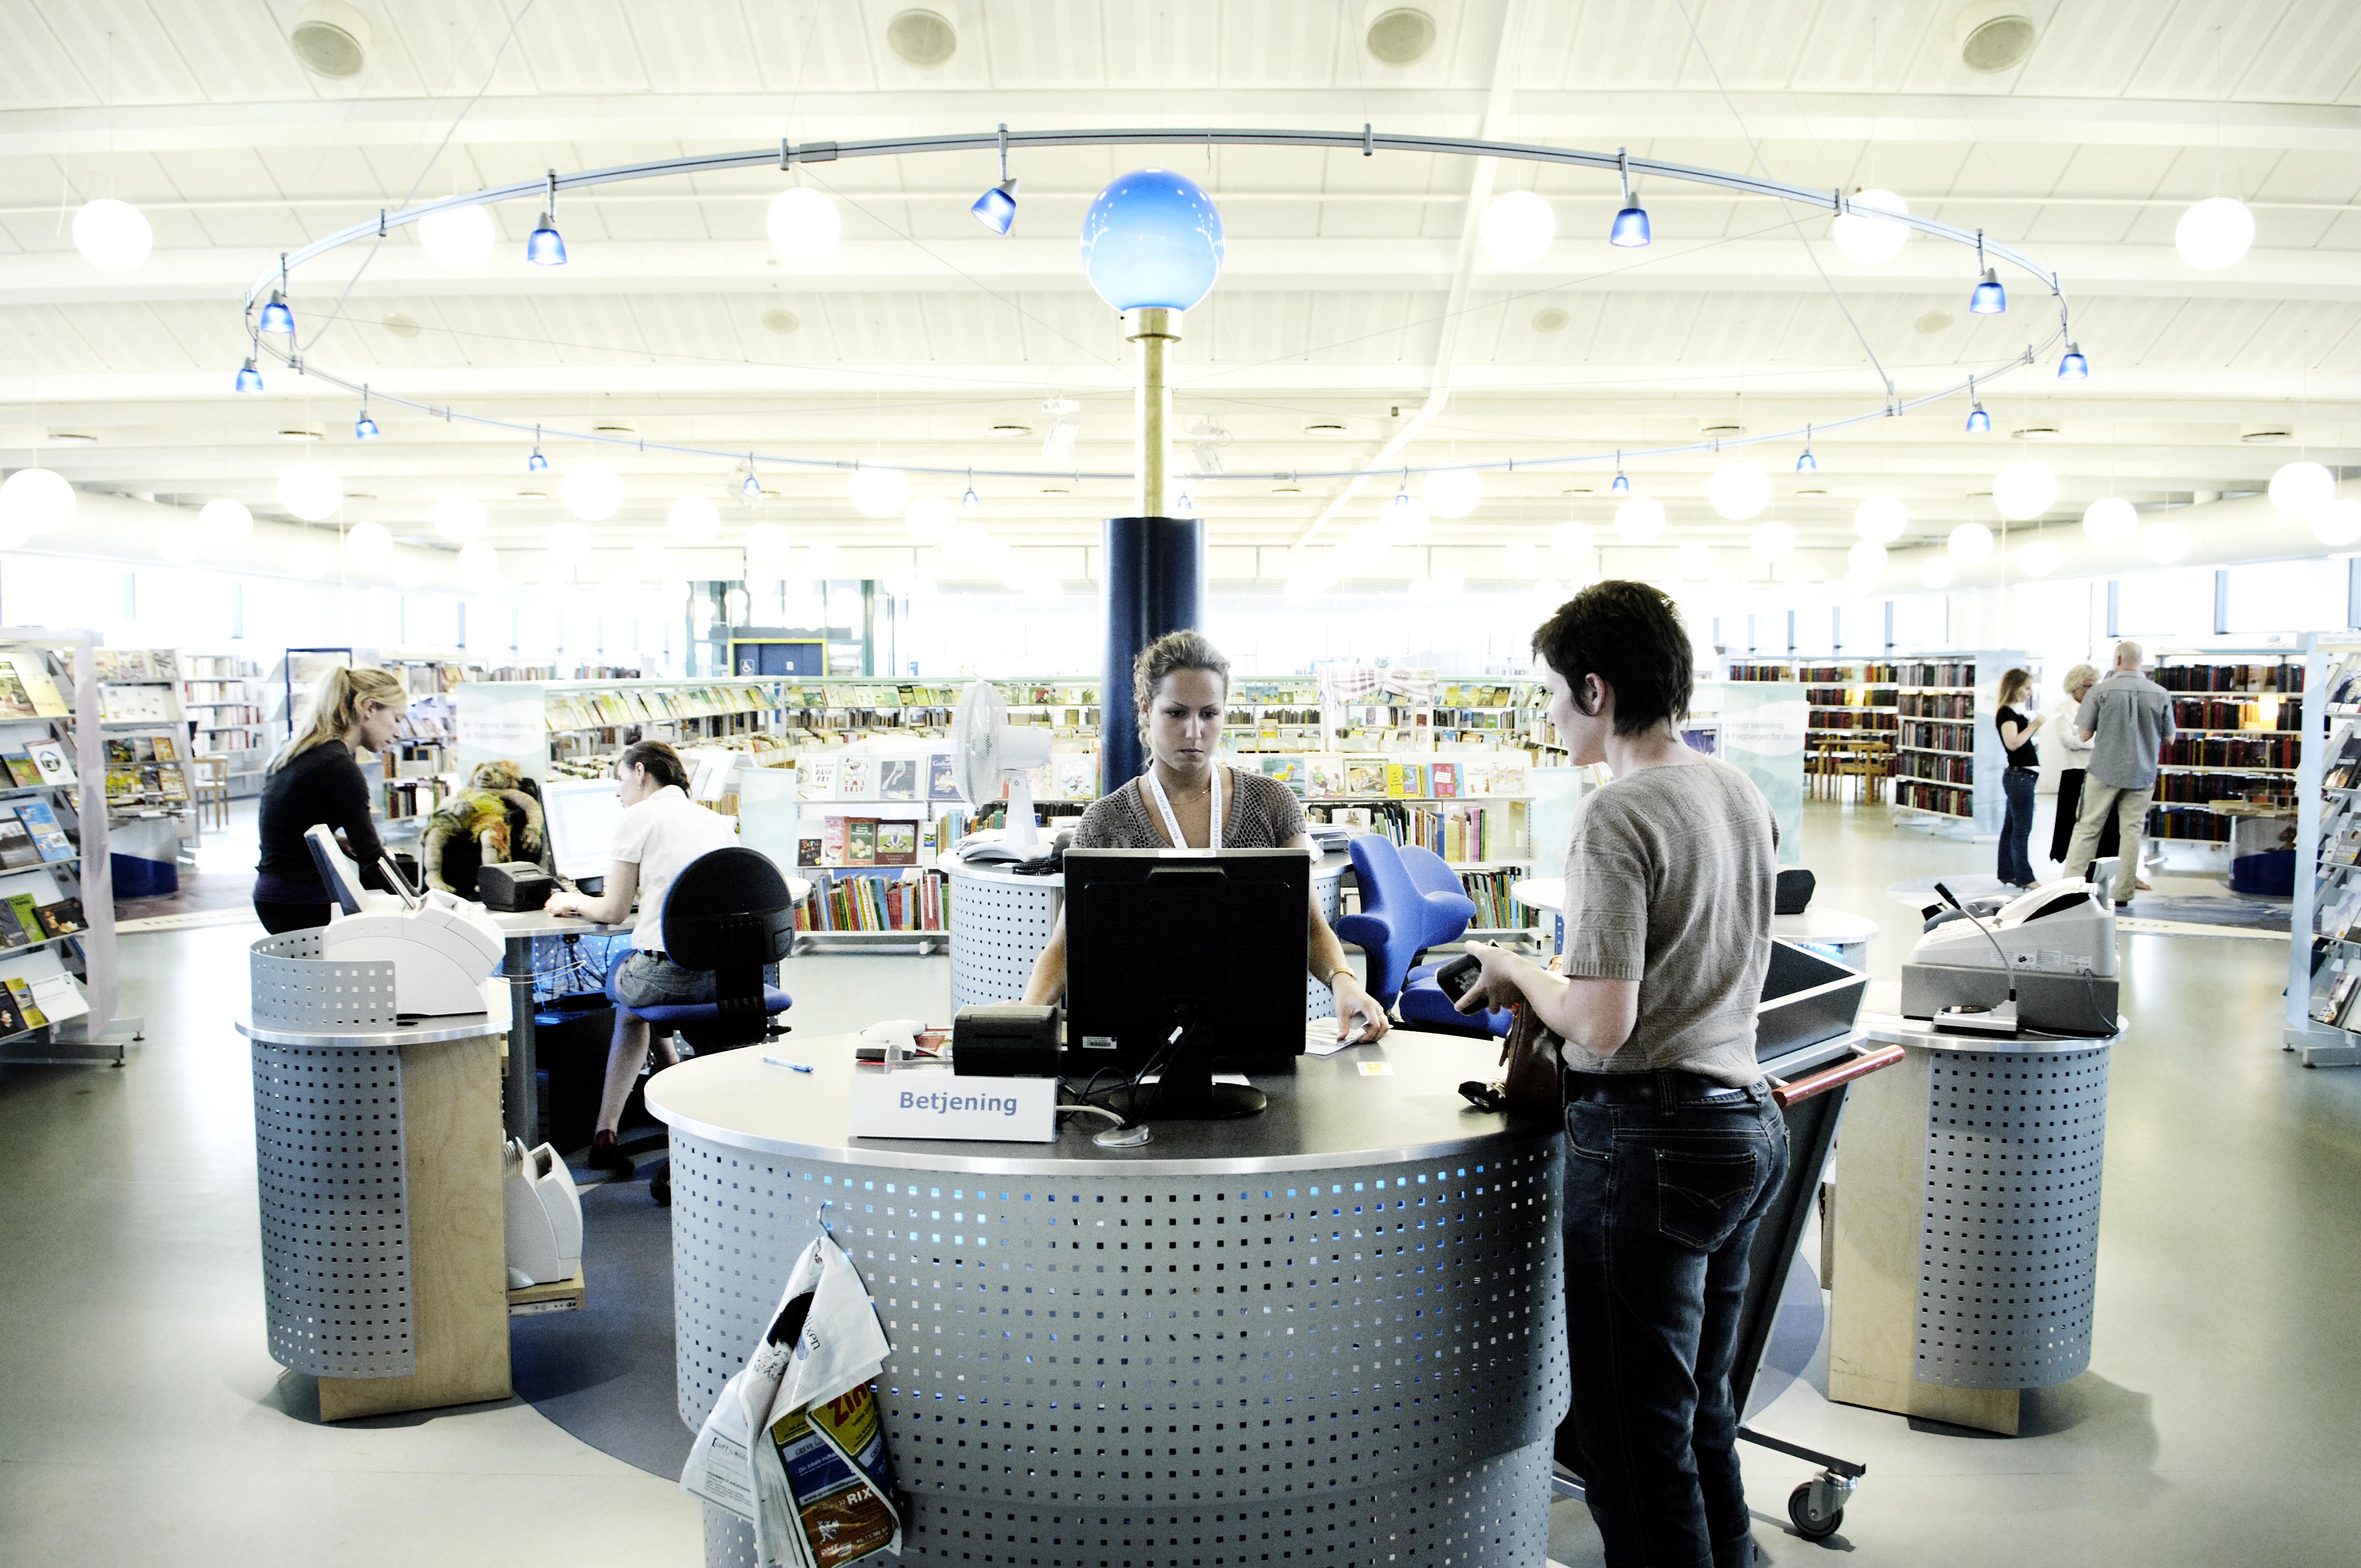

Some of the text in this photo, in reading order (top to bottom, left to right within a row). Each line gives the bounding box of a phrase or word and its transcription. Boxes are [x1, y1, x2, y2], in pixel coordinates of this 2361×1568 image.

[900, 1092, 1017, 1116] Betjening
[804, 1312, 820, 1350] lixen
[828, 1380, 871, 1427] Zin
[847, 1488, 873, 1505] RIX
